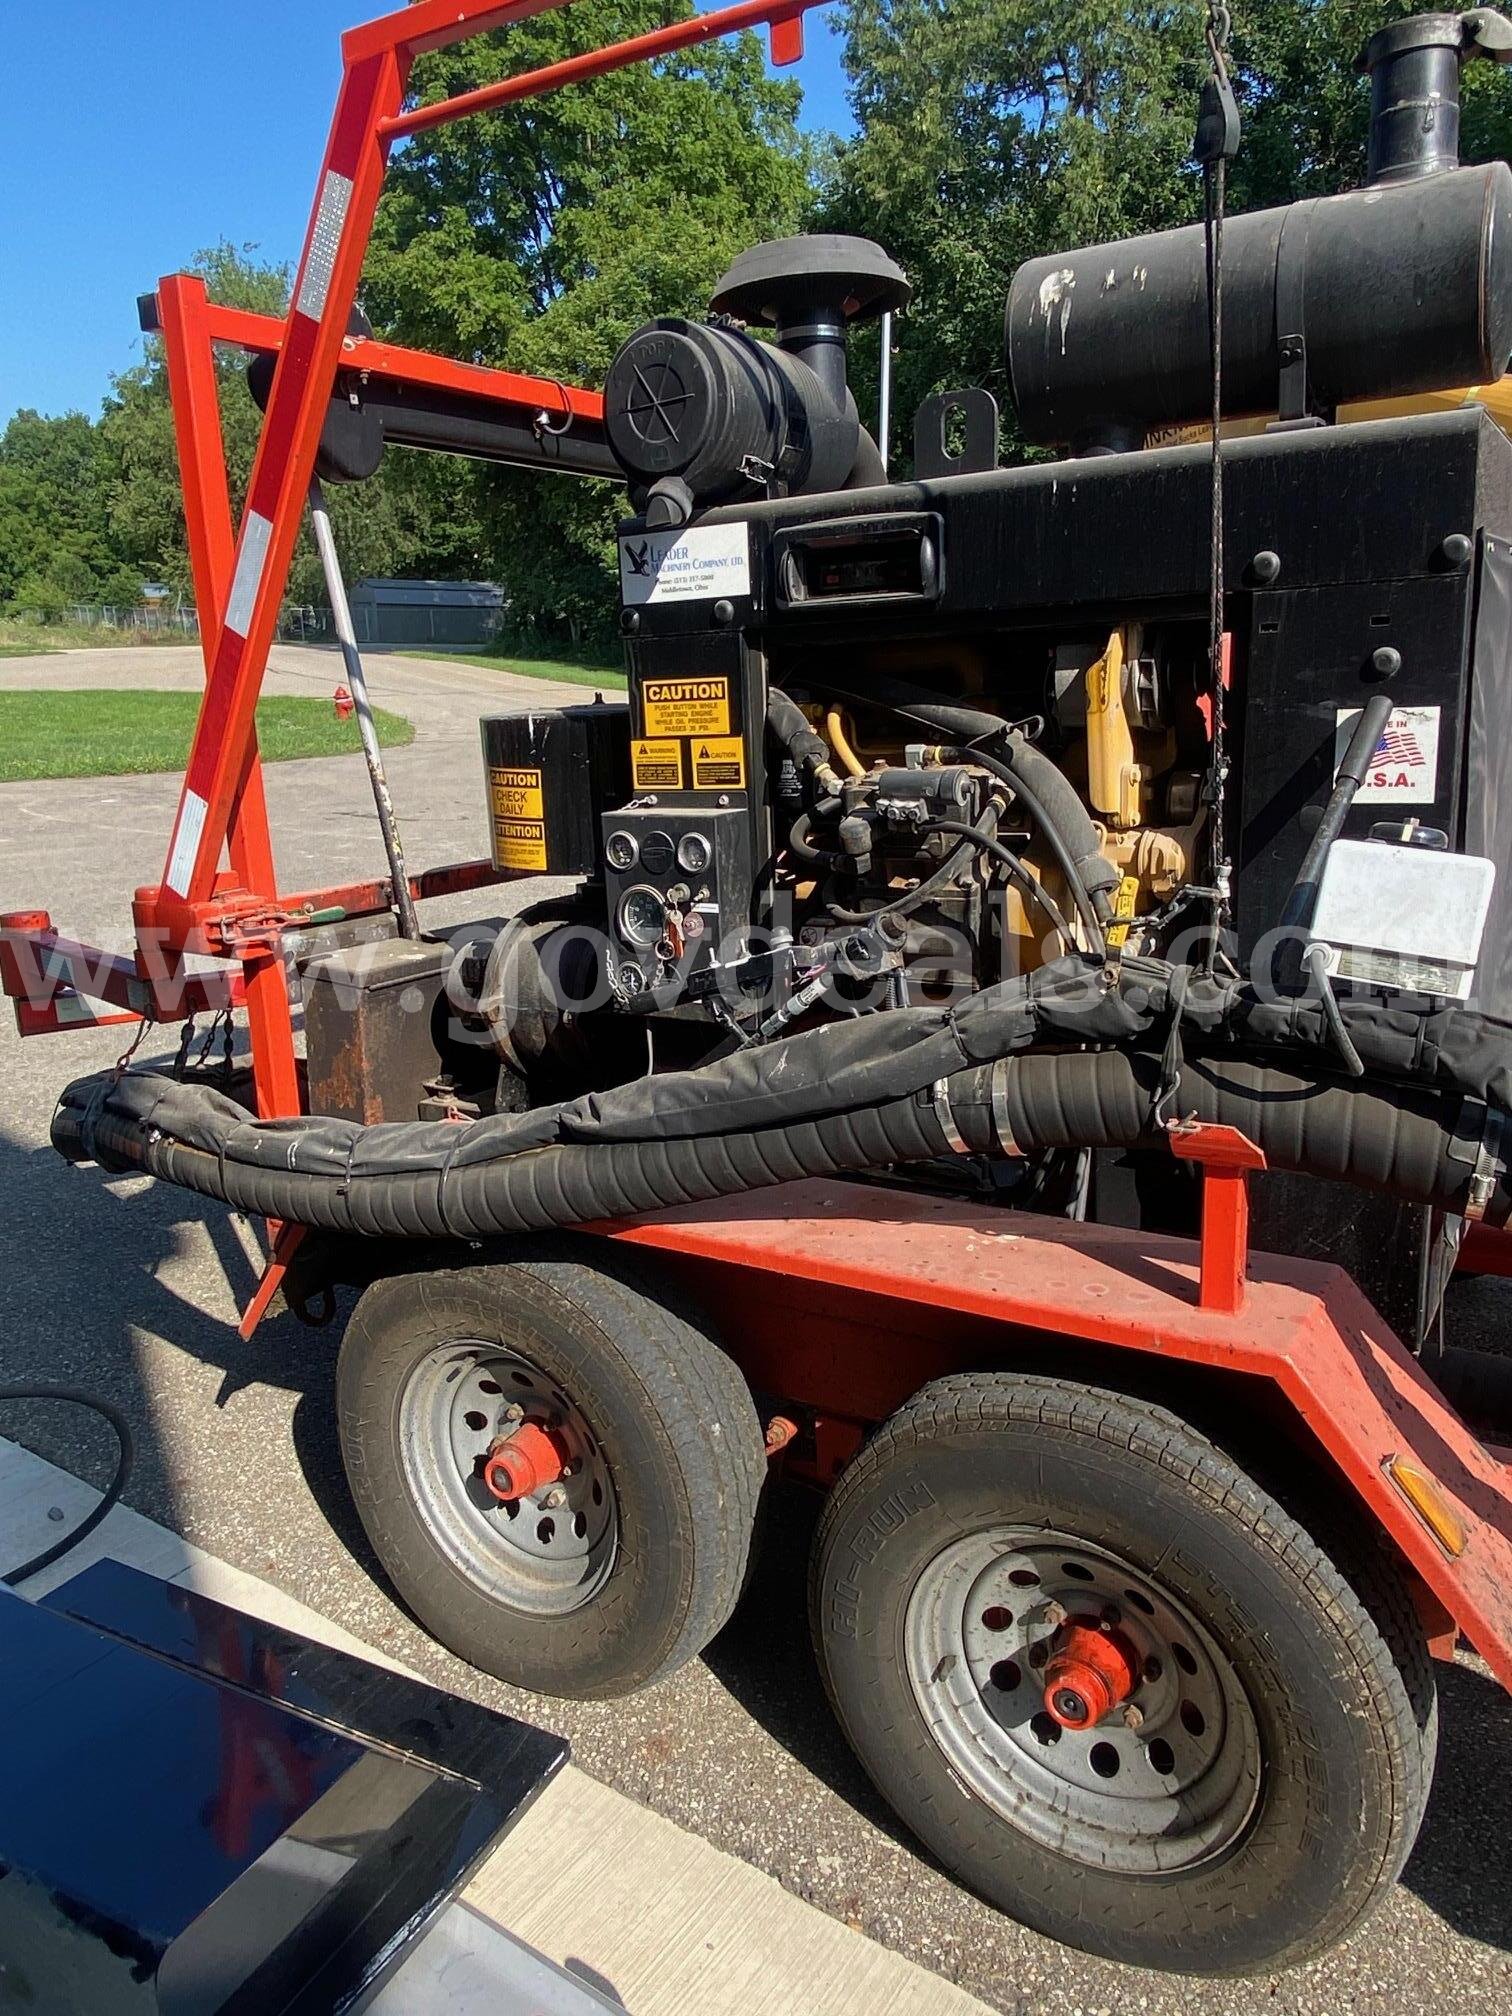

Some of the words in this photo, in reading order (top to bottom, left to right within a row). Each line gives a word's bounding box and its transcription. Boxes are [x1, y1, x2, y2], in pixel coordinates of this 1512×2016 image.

[650, 545, 689, 563] LEADER
[650, 562, 691, 573] MACHINERY
[648, 683, 723, 701] CAUTION
[699, 701, 718, 709] WHILE
[691, 709, 713, 717] ENGINE
[688, 716, 719, 724] PRESSURE
[1396, 720, 1408, 729] IN
[711, 751, 736, 759] CAUTION
[1366, 772, 1416, 788] .S.A.
[496, 790, 527, 803] CHECK
[500, 803, 524, 815] DAILY
[831, 1480, 937, 1641] HI-RUN
